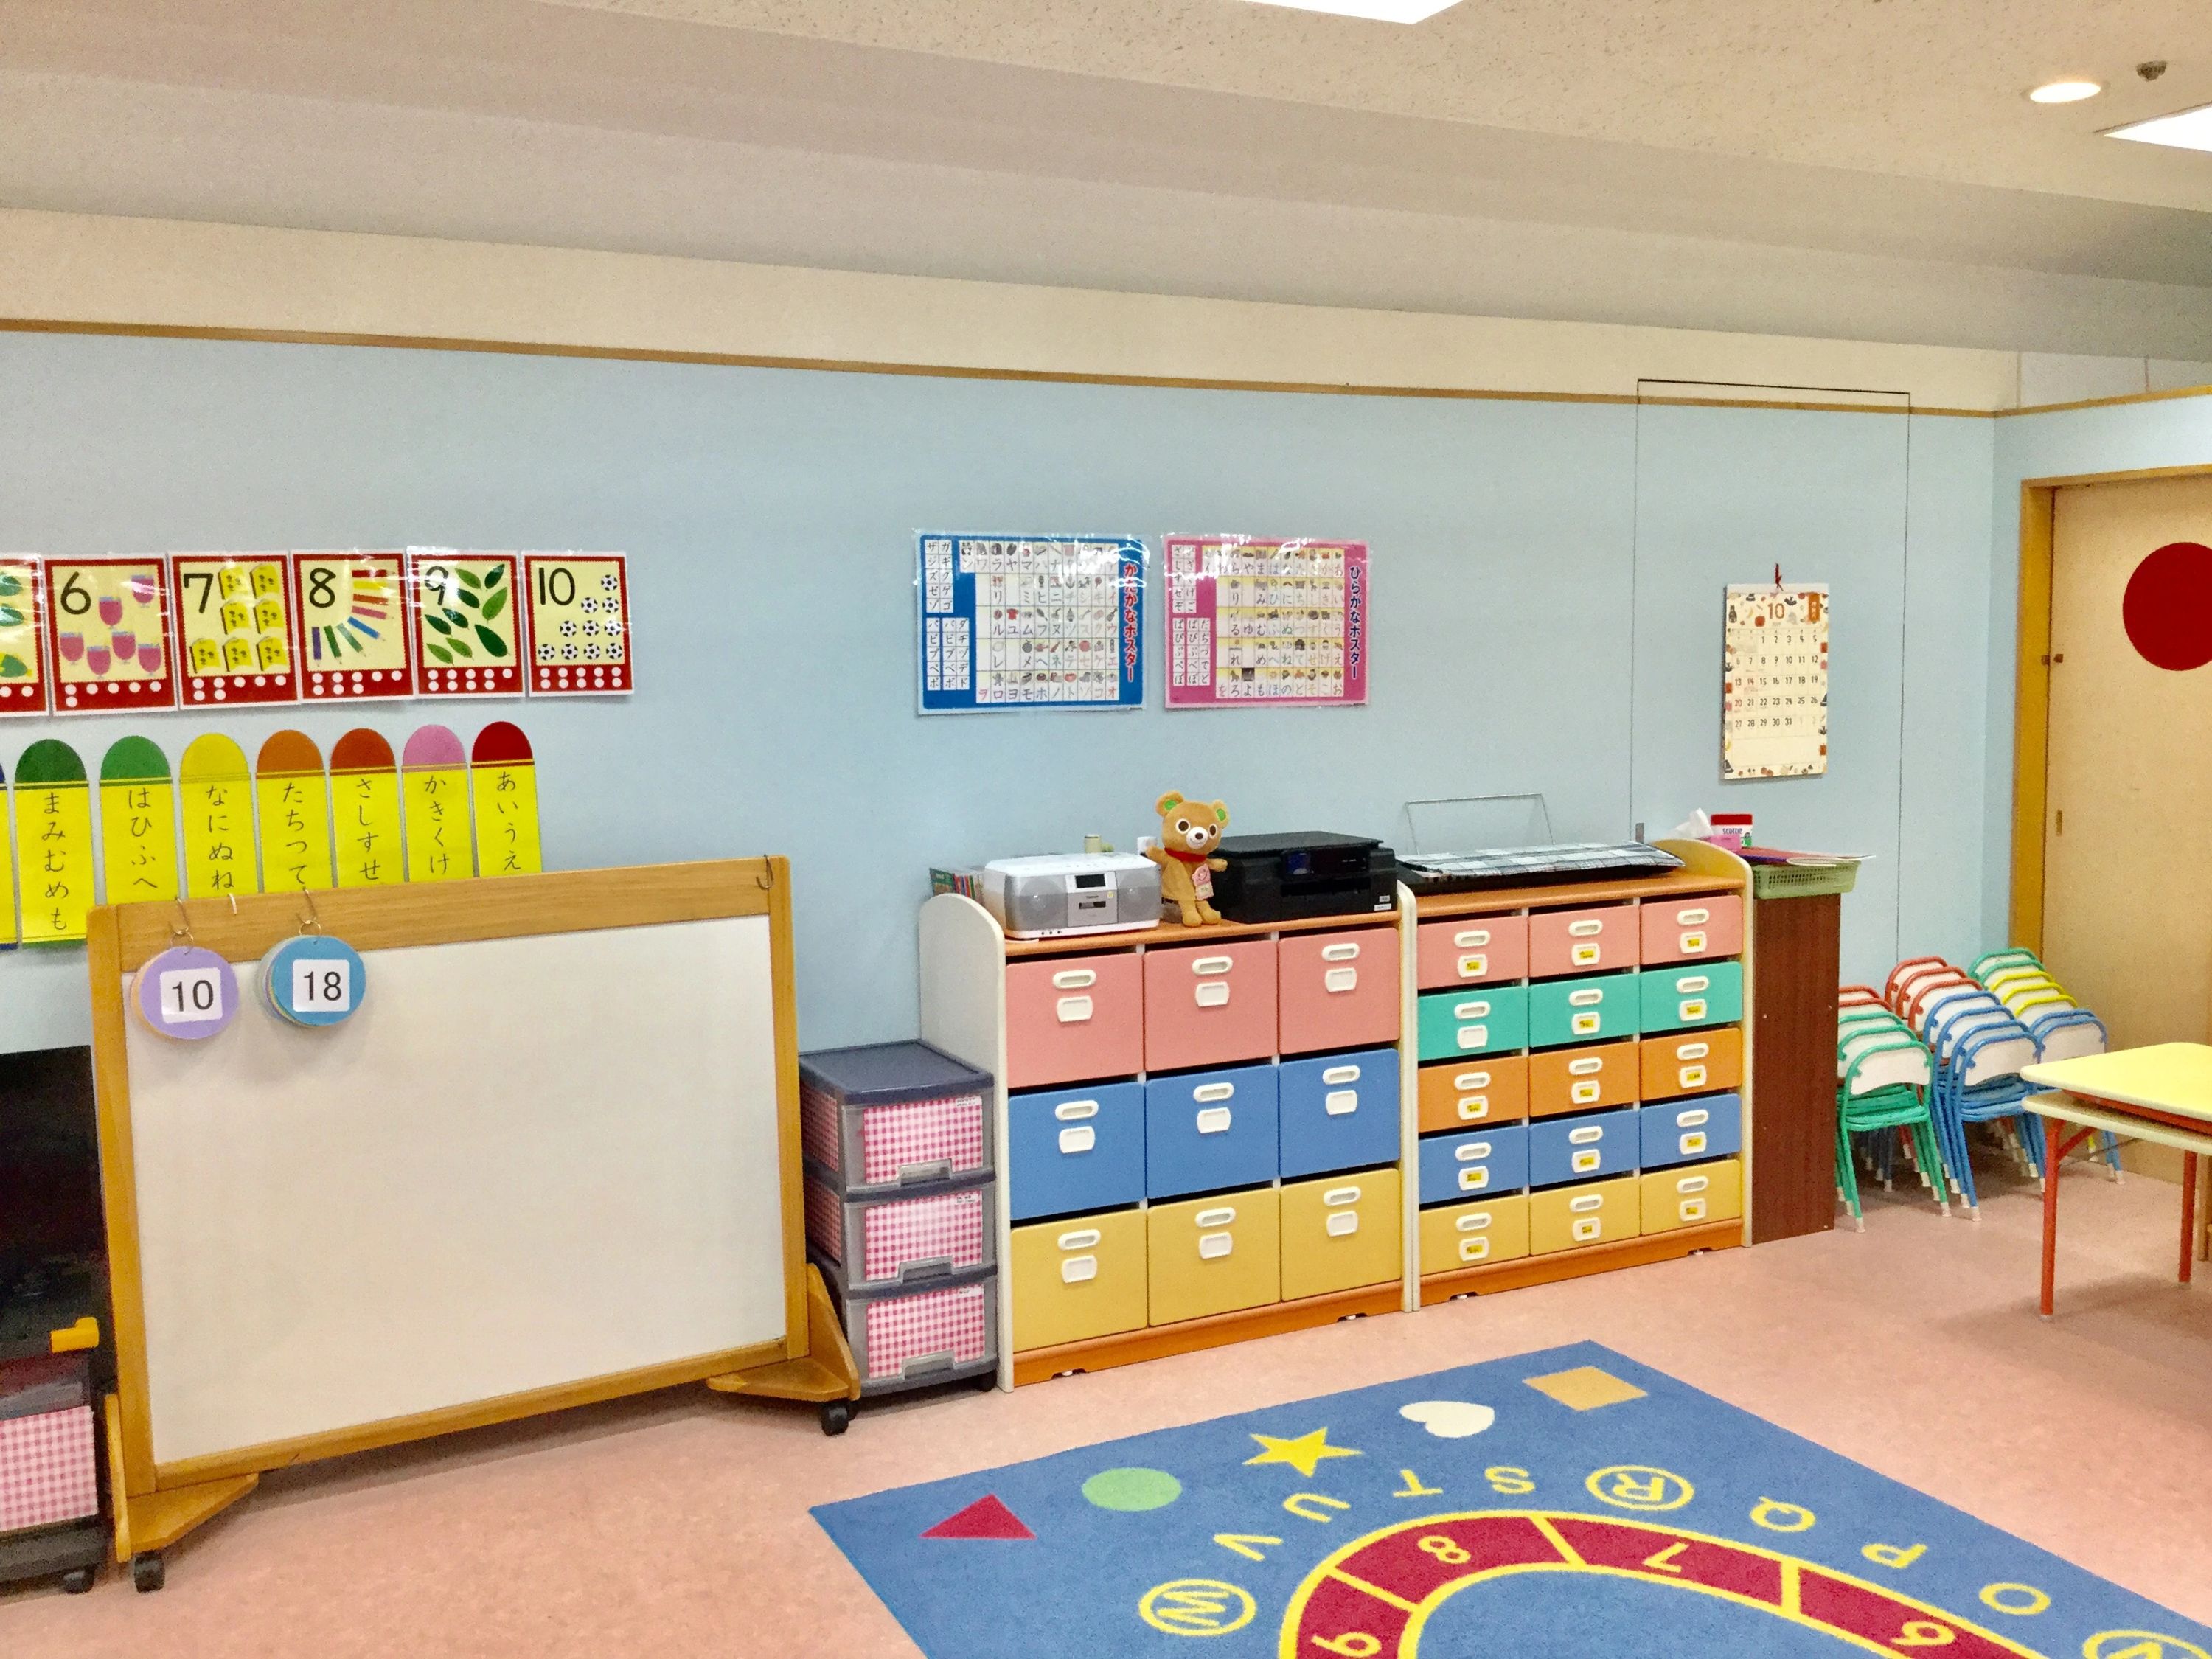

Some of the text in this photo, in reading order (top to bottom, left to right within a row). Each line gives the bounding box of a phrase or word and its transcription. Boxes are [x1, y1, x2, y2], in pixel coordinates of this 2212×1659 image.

[992, 559, 1002, 571] ラ
[1006, 558, 1018, 571] ヤ
[1021, 561, 1032, 570] マ
[1051, 560, 1061, 571] ナ
[1232, 562, 1240, 574] ら
[1244, 562, 1254, 574] や
[1257, 563, 1265, 574] ま
[1270, 563, 1280, 574] は
[60, 566, 575, 614] 6 7 8 9 10
[994, 591, 1002, 604] リ
[1023, 591, 1030, 603] ミ
[1038, 591, 1046, 603] ヒ
[1051, 593, 1062, 602] ニ
[1109, 591, 1116, 605] イ
[1232, 593, 1239, 605] り
[1256, 594, 1265, 604] み
[1270, 594, 1279, 605] ひ
[1283, 594, 1292, 604] に
[1767, 602, 1784, 619] 10
[993, 624, 1004, 636] ル
[1007, 625, 1018, 635] ユ
[1023, 625, 1033, 635] ム
[1037, 625, 1047, 636] フ
[1052, 625, 1061, 635] ヌ
[1107, 623, 1117, 636] ウ
[1231, 624, 1239, 636] る
[1244, 624, 1253, 634] ゆ
[1257, 625, 1265, 636] む
[1282, 625, 1292, 634] ぬ
[1774, 636, 1778, 644] 2
[1787, 635, 1792, 644] 3
[1812, 634, 1817, 643] 5
[994, 655, 1004, 668] レ
[1023, 656, 1032, 667] メ
[1052, 654, 1062, 668] ネ
[1108, 656, 1117, 666] エ
[1231, 654, 1240, 665] れ
[1256, 655, 1266, 664] め
[1282, 655, 1292, 665] ね
[1748, 657, 1753, 665] 7
[1761, 656, 1766, 664] 8
[1774, 655, 1778, 664] 9
[1785, 655, 1793, 664] 10
[1798, 655, 1805, 664] 11
[1812, 655, 1819, 663] 12
[1759, 677, 1767, 686] 15
[1773, 677, 1780, 685] 16
[1785, 676, 1792, 684] 17
[1798, 676, 1806, 684] 18
[1811, 675, 1818, 684] 19
[978, 689, 988, 700] ヲ
[993, 690, 1004, 699] ロ
[1008, 689, 1018, 700] ヨ
[1022, 689, 1033, 700] モ
[1036, 686, 1047, 700] ホ
[1052, 686, 1060, 699] ノ
[1095, 688, 1103, 698] コ
[1108, 686, 1116, 699] オ
[1231, 685, 1239, 697] ろ
[1244, 684, 1252, 696] よ
[1258, 684, 1265, 696] も
[1281, 685, 1292, 695] の
[1296, 685, 1304, 695] と
[1333, 684, 1342, 695] お
[1734, 699, 1742, 707] 20
[1747, 698, 1754, 706] 21
[1759, 698, 1767, 706] 22
[1772, 697, 1781, 706] 23
[1798, 696, 1805, 705] 25
[1810, 696, 1818, 704] 26
[1735, 720, 1742, 728] 27
[1747, 719, 1755, 727] 28
[1760, 718, 1767, 726] 29
[1772, 718, 1780, 726] 30
[1784, 717, 1792, 726] 31
[424, 775, 450, 874] かきくけ
[497, 771, 522, 872] あいうえ
[283, 782, 307, 885] たちつて
[357, 778, 381, 880] さしすせ
[128, 790, 158, 888] はひふへ
[206, 785, 234, 890] なにぬね
[42, 793, 68, 931] まみむめも
[304, 971, 342, 1001] 18
[173, 979, 214, 1012] 10
[1213, 1531, 1283, 1561] V
[1284, 1492, 1351, 1523] U
[1393, 1470, 1443, 1498] T
[1483, 1465, 1535, 1495] S
[1612, 1473, 1669, 1503] R
[1750, 1495, 1816, 1533] Q
[1860, 1541, 1928, 1569] P
[1417, 1534, 1472, 1564] 8
[1644, 1541, 1691, 1573] 7
